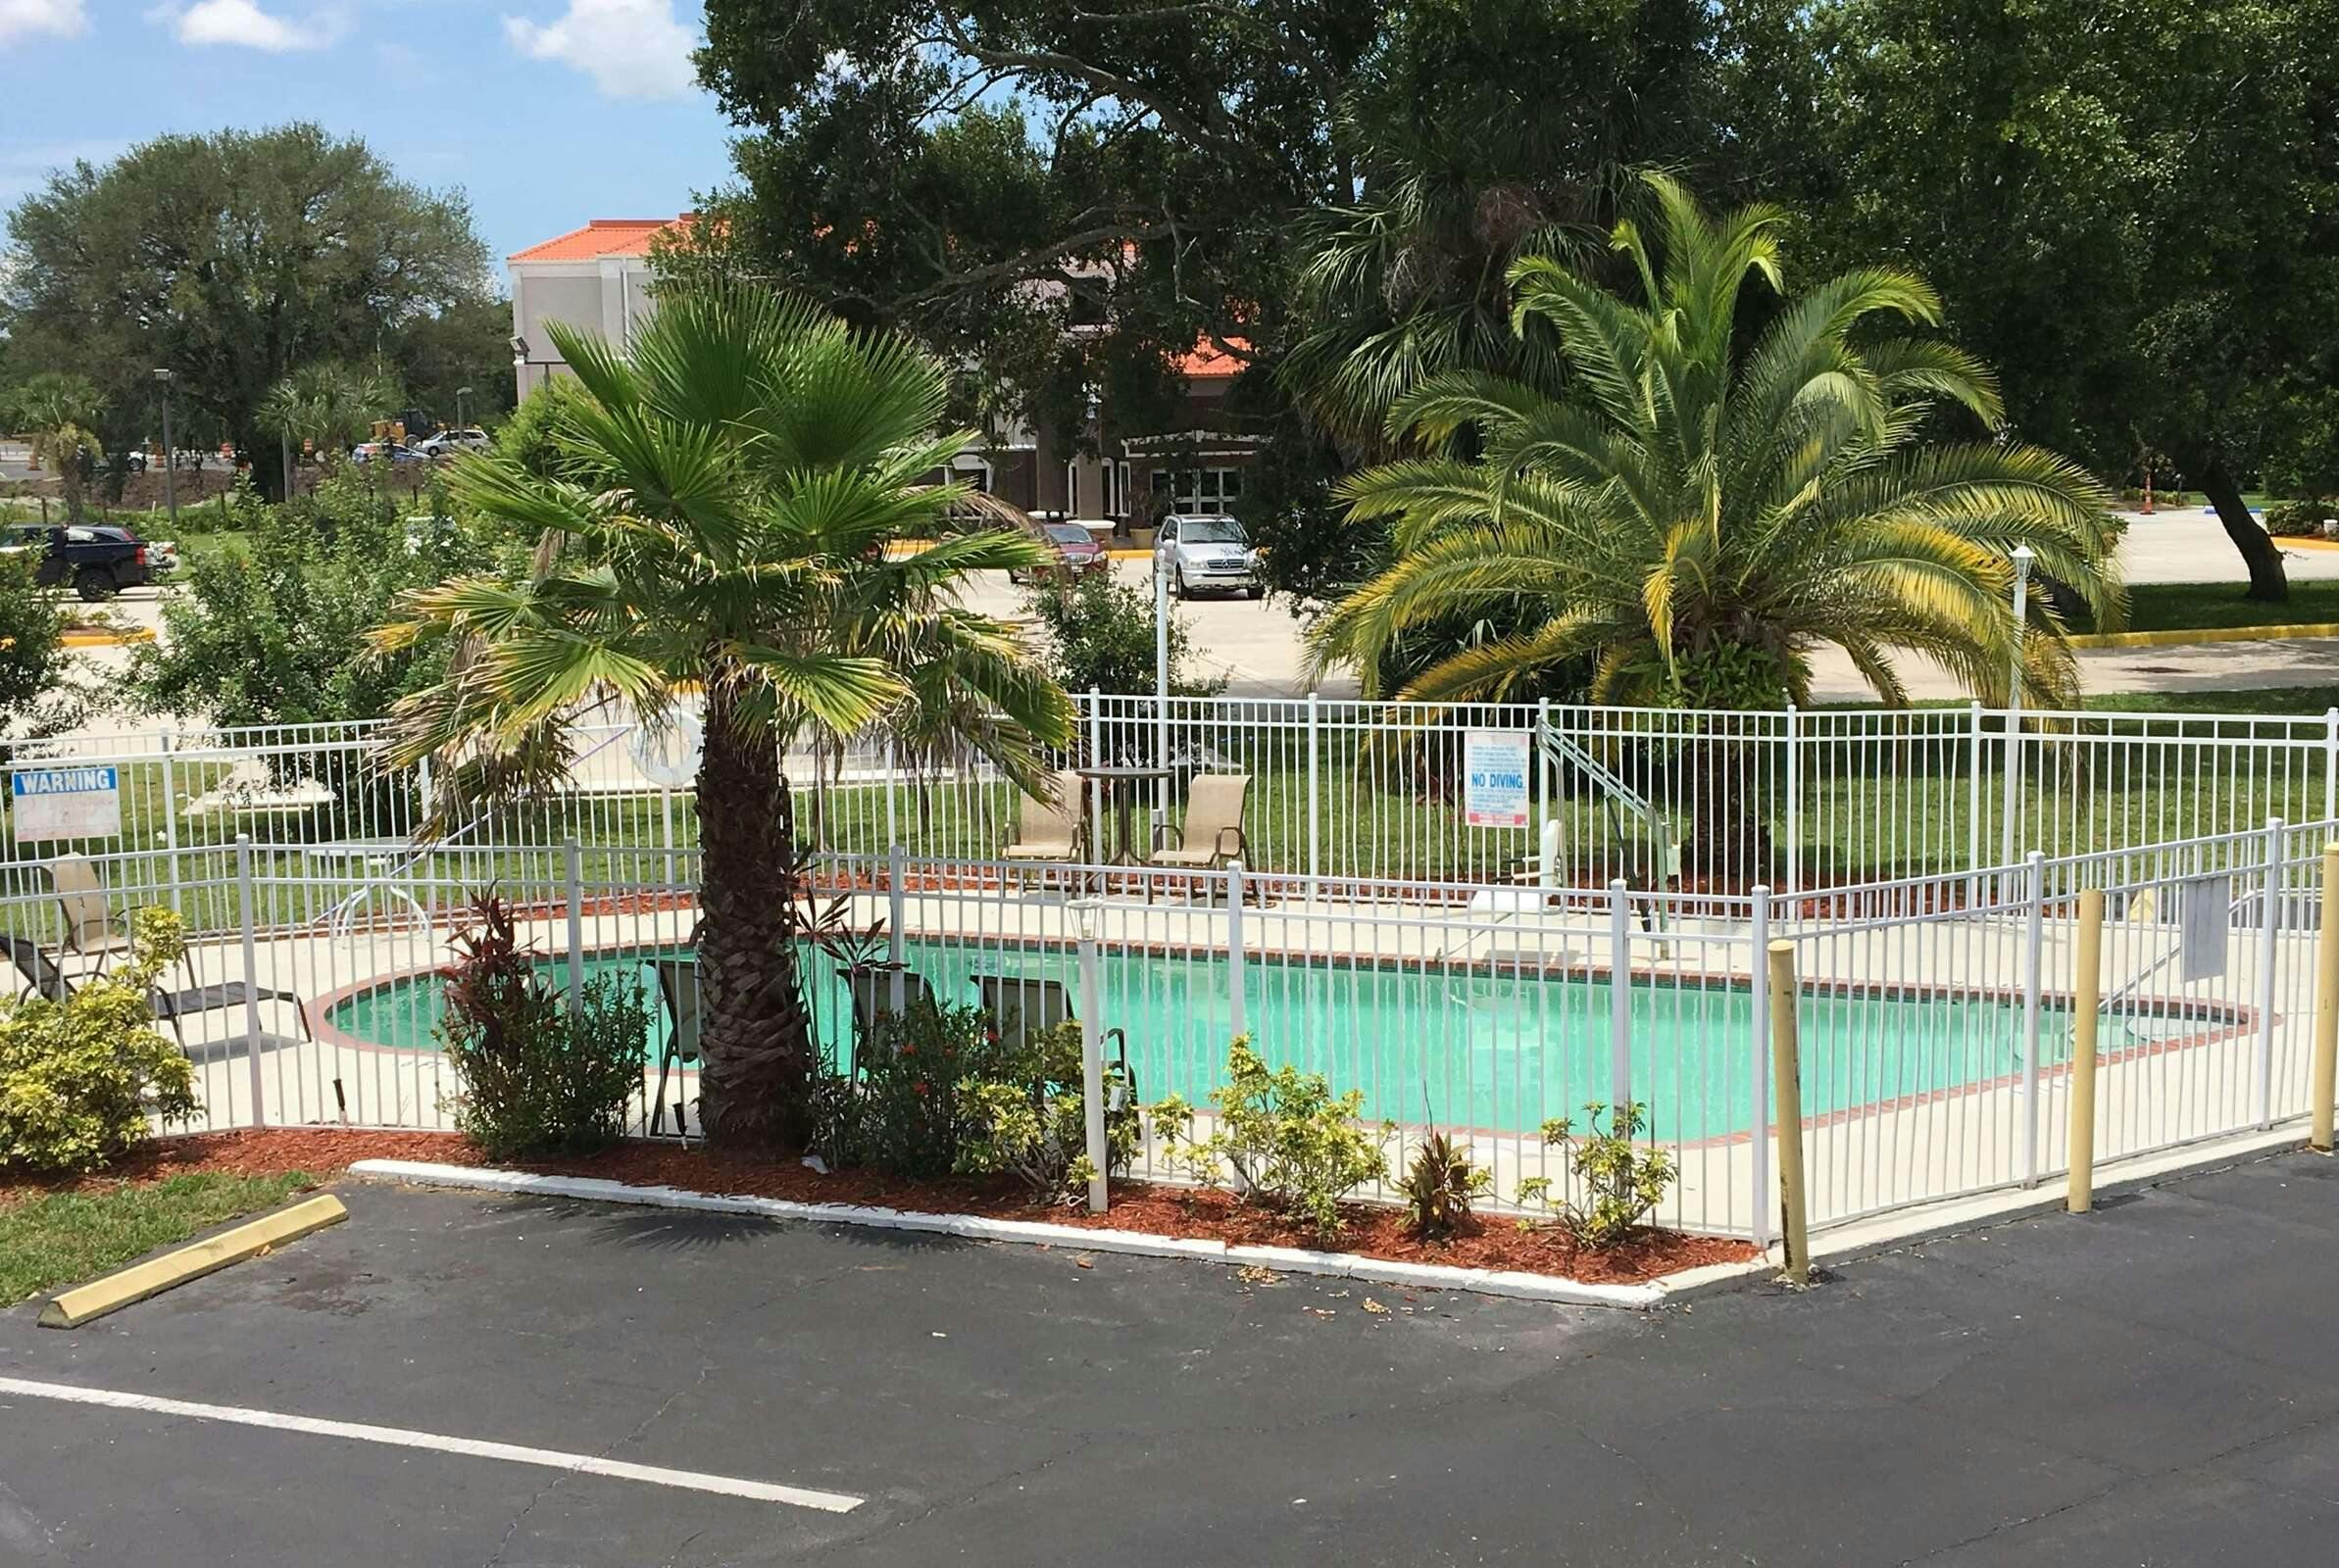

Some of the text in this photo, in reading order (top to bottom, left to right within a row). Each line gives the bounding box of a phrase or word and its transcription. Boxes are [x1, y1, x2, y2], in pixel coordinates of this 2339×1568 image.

[22, 769, 110, 793] WARNING
[1471, 773, 1523, 789] NO DIVING
